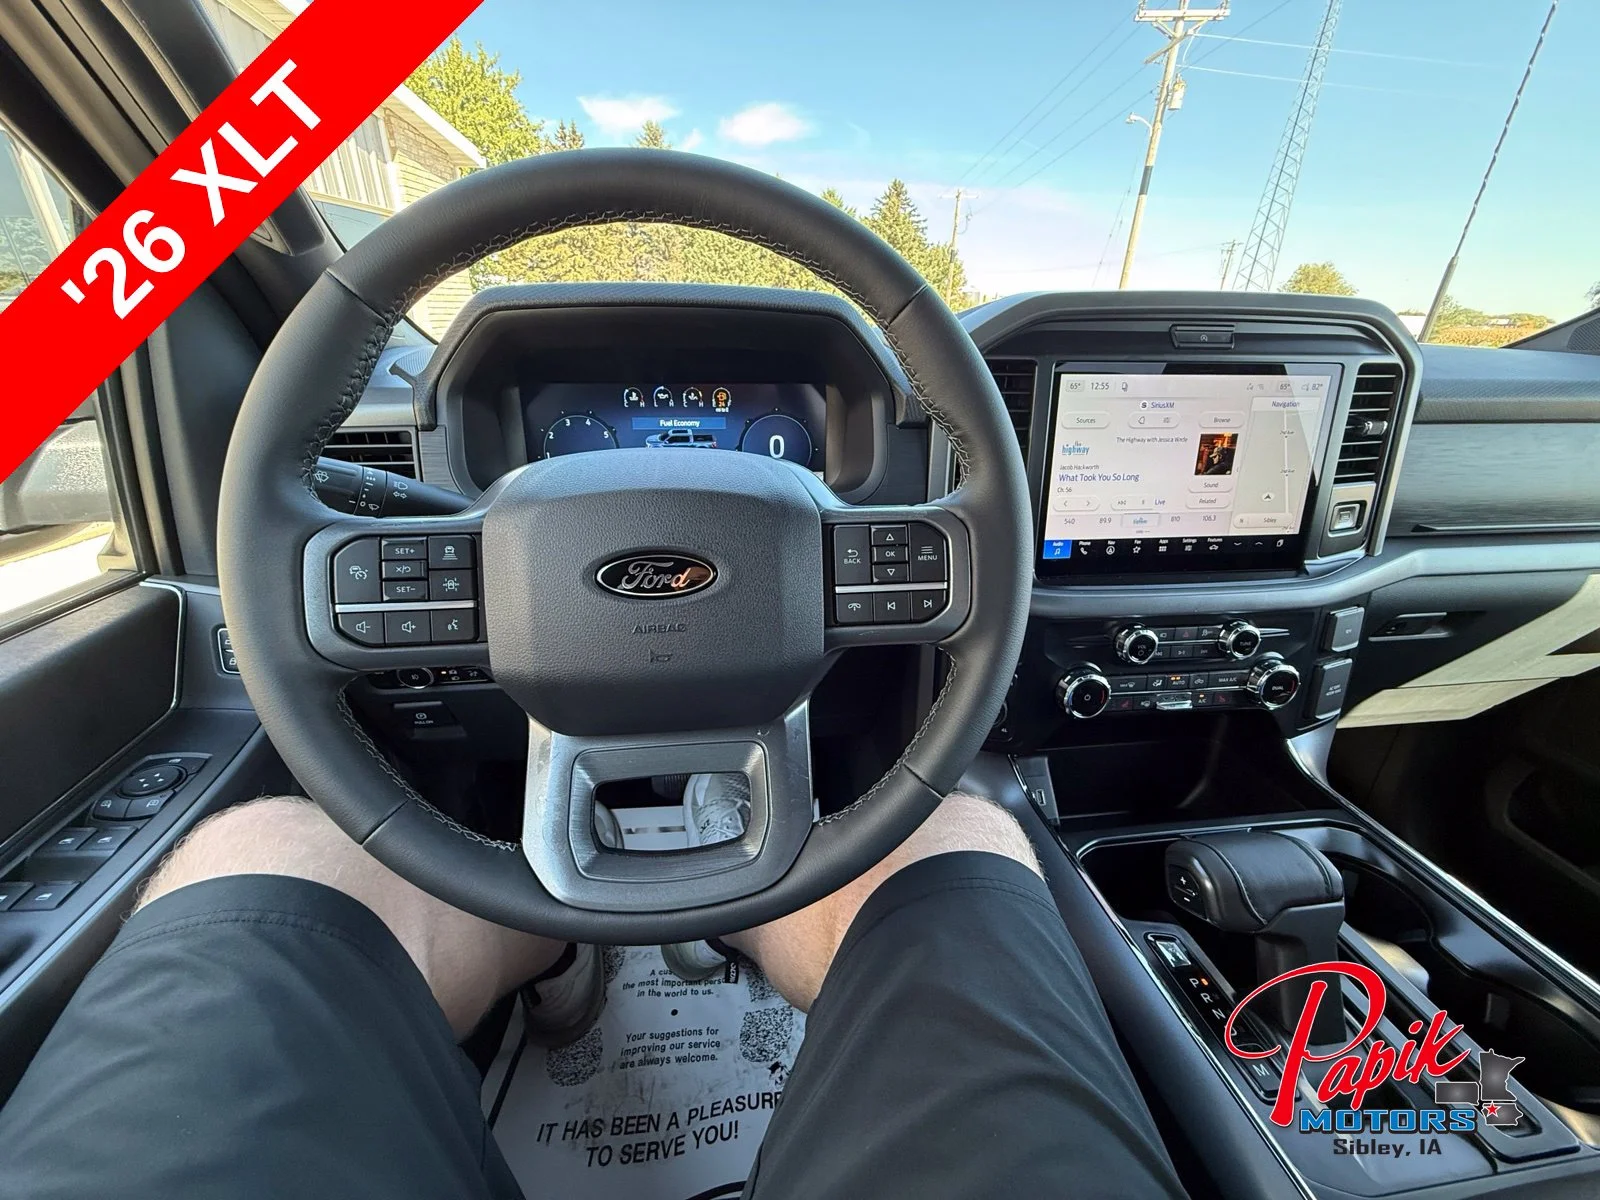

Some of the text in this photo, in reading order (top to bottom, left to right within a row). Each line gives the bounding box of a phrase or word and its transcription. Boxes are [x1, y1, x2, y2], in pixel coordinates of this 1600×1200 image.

[1091, 382, 1110, 390] 12:55
[565, 419, 571, 427] 3
[674, 420, 700, 428] Economy
[548, 431, 554, 439] 2
[603, 431, 609, 439] 5
[769, 435, 785, 459] 0
[1061, 444, 1090, 455] highway
[1059, 474, 1078, 482] What
[1098, 473, 1111, 481] You
[1123, 473, 1140, 482] Long
[395, 547, 415, 555] SET+
[617, 560, 692, 590] Ford
[632, 623, 686, 634] AIRBAG
[649, 969, 656, 977] A
[622, 982, 635, 991] the
[637, 979, 659, 988] most
[661, 977, 702, 988] important
[1189, 977, 1199, 988] P
[636, 990, 646, 998] in
[647, 989, 662, 997] the
[664, 988, 688, 998] world
[690, 988, 699, 996] to
[1200, 992, 1213, 1003] R
[1211, 1007, 1226, 1020] N
[625, 1026, 719, 1044] Your suggestions for
[620, 1039, 721, 1057] improving our service
[619, 1052, 719, 1070] are always welcome.
[1252, 1062, 1271, 1077] M
[536, 1121, 559, 1143] IT
[561, 1117, 605, 1142] HAS
[610, 1112, 661, 1136] BEEN
[666, 1111, 680, 1131] A
[586, 1120, 739, 1168] TO SERVE YOU!
